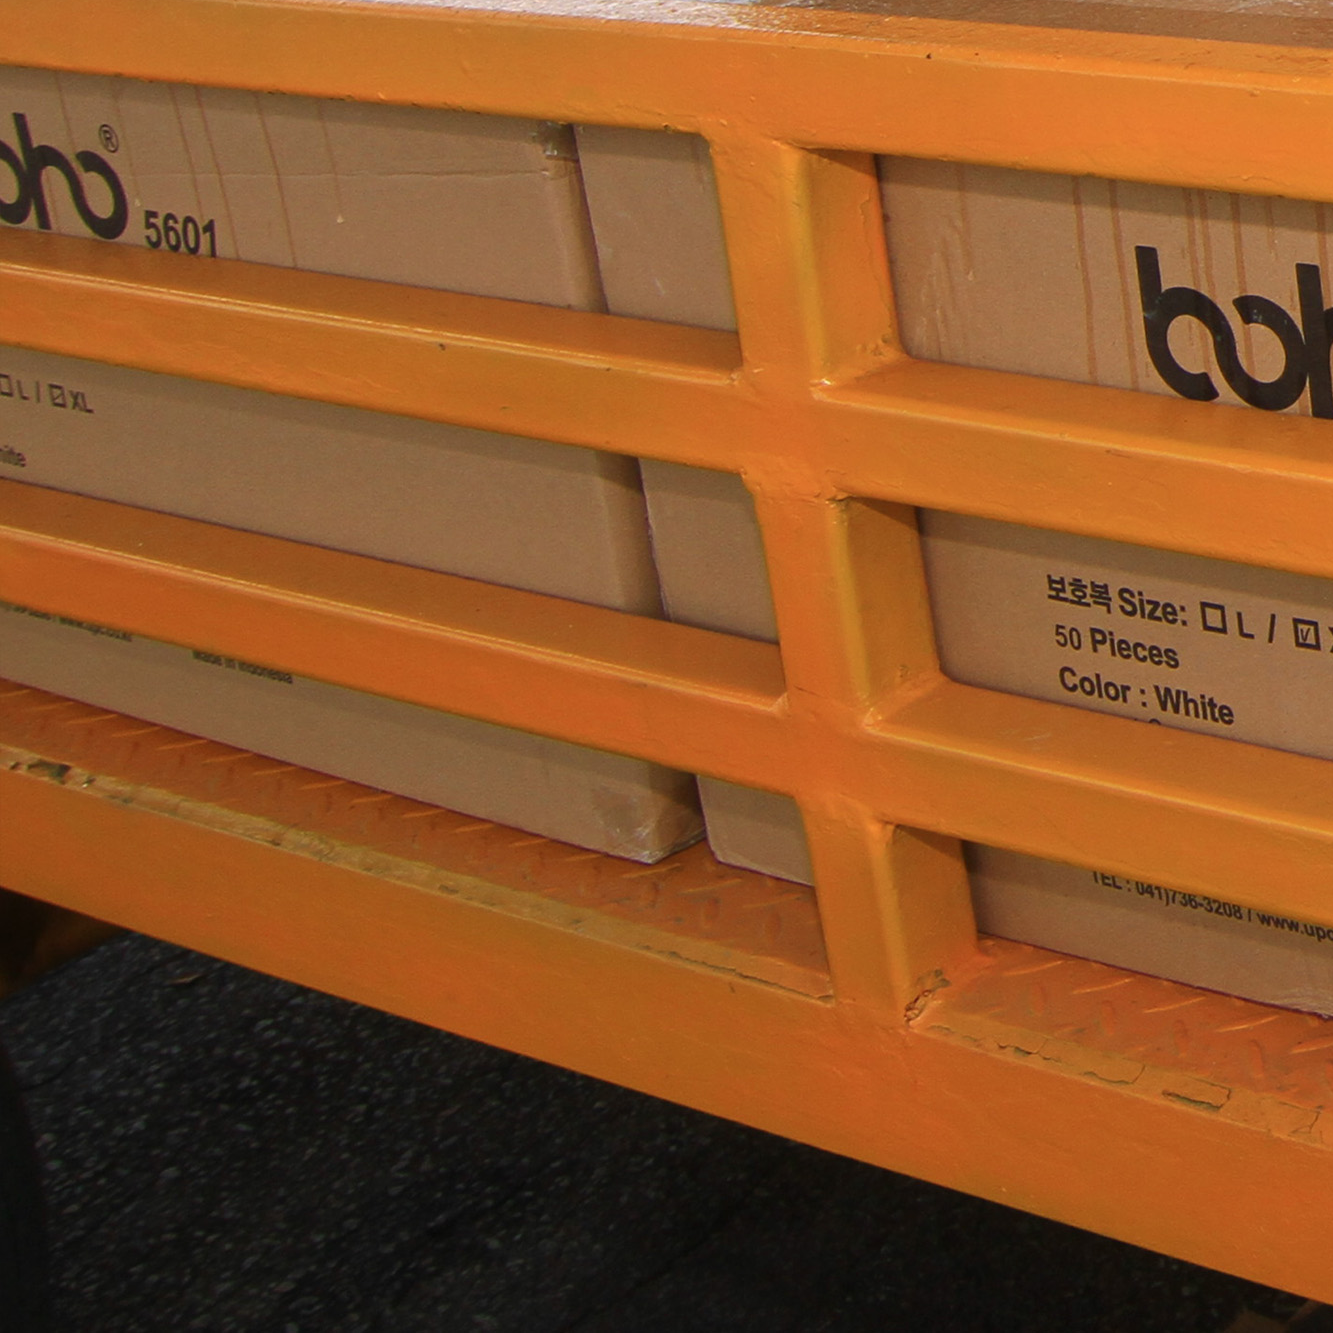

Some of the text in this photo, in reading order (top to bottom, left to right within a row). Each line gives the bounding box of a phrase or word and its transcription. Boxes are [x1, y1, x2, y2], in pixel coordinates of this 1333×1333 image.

[145, 210, 217, 258] 5601
[1046, 574, 1112, 615] 보호복
[1118, 587, 1188, 628] Size:
[1237, 609, 1255, 639] L
[1054, 624, 1180, 670] 50 Pieces
[1058, 665, 1131, 706] Color
[1154, 684, 1235, 727] White
[1093, 869, 1123, 892] TEL
